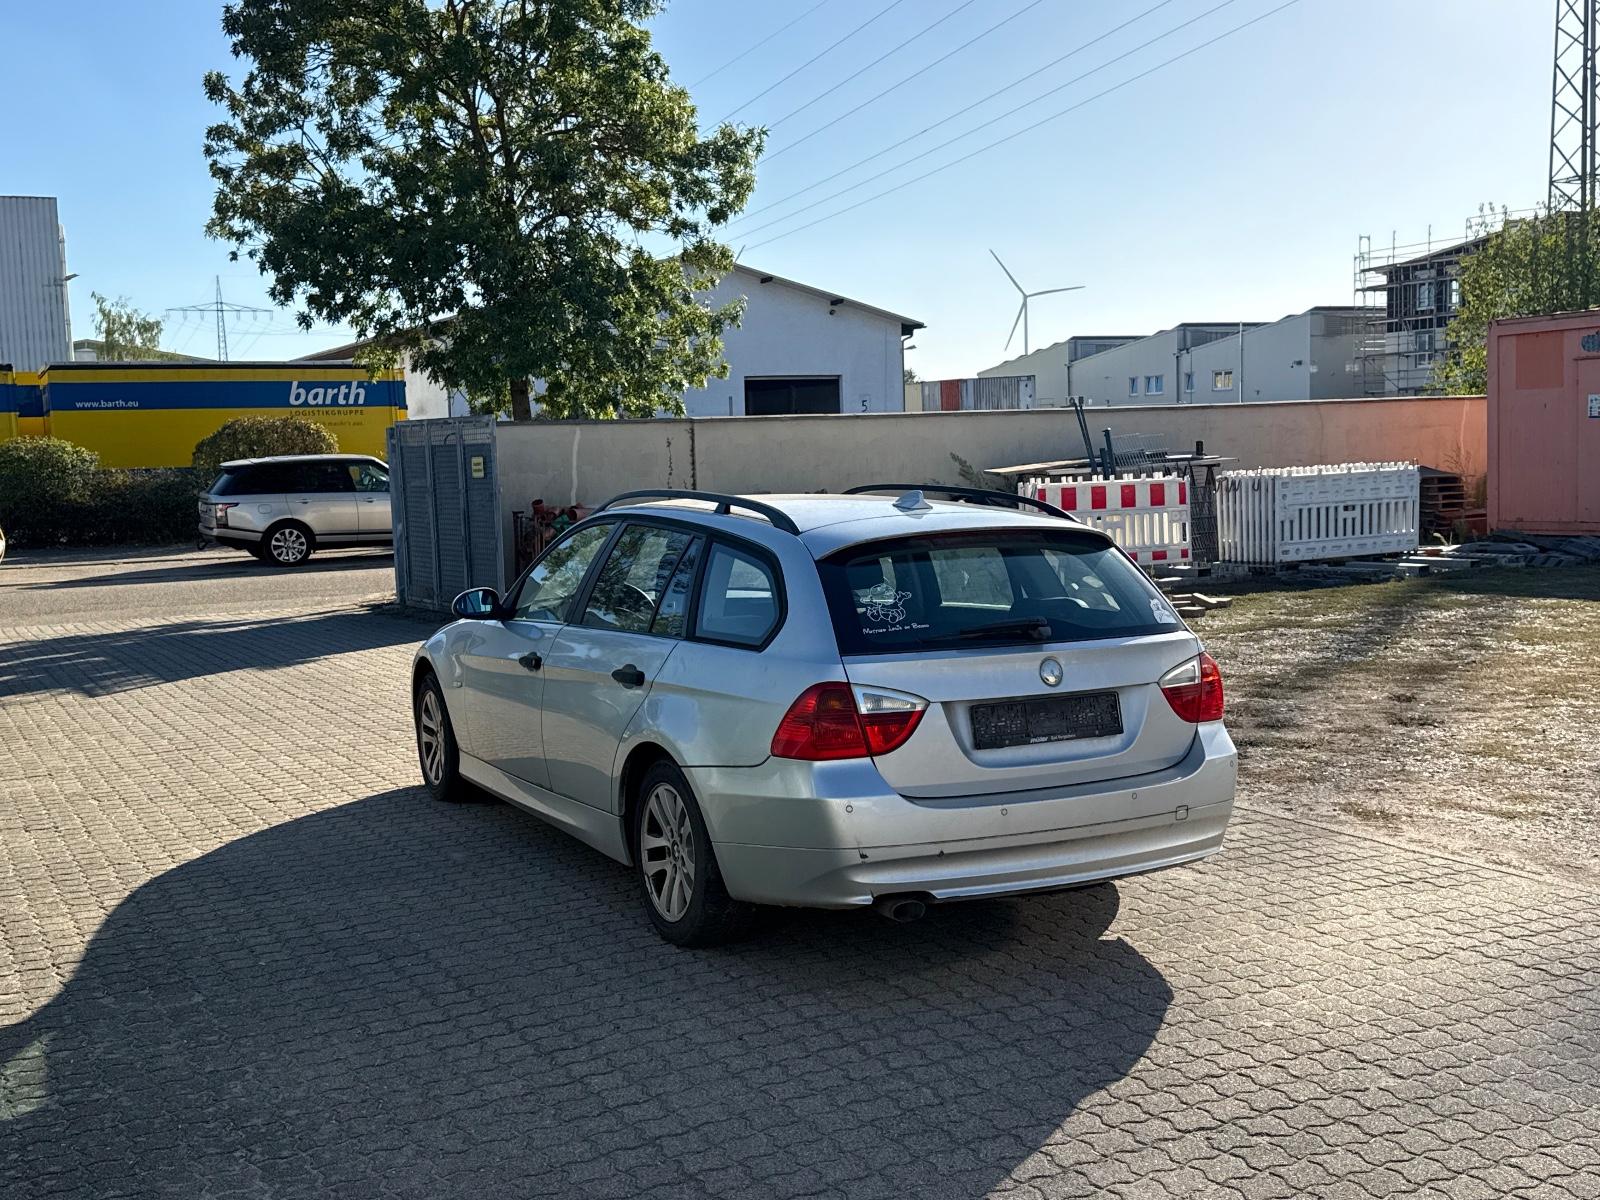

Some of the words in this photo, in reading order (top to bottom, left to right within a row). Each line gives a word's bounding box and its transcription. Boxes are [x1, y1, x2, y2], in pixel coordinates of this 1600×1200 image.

[289, 380, 366, 406] barth
[75, 400, 139, 408] www.barth.eu
[861, 399, 868, 413] 5
[289, 409, 364, 417] LOGISTIKGRUPPE
